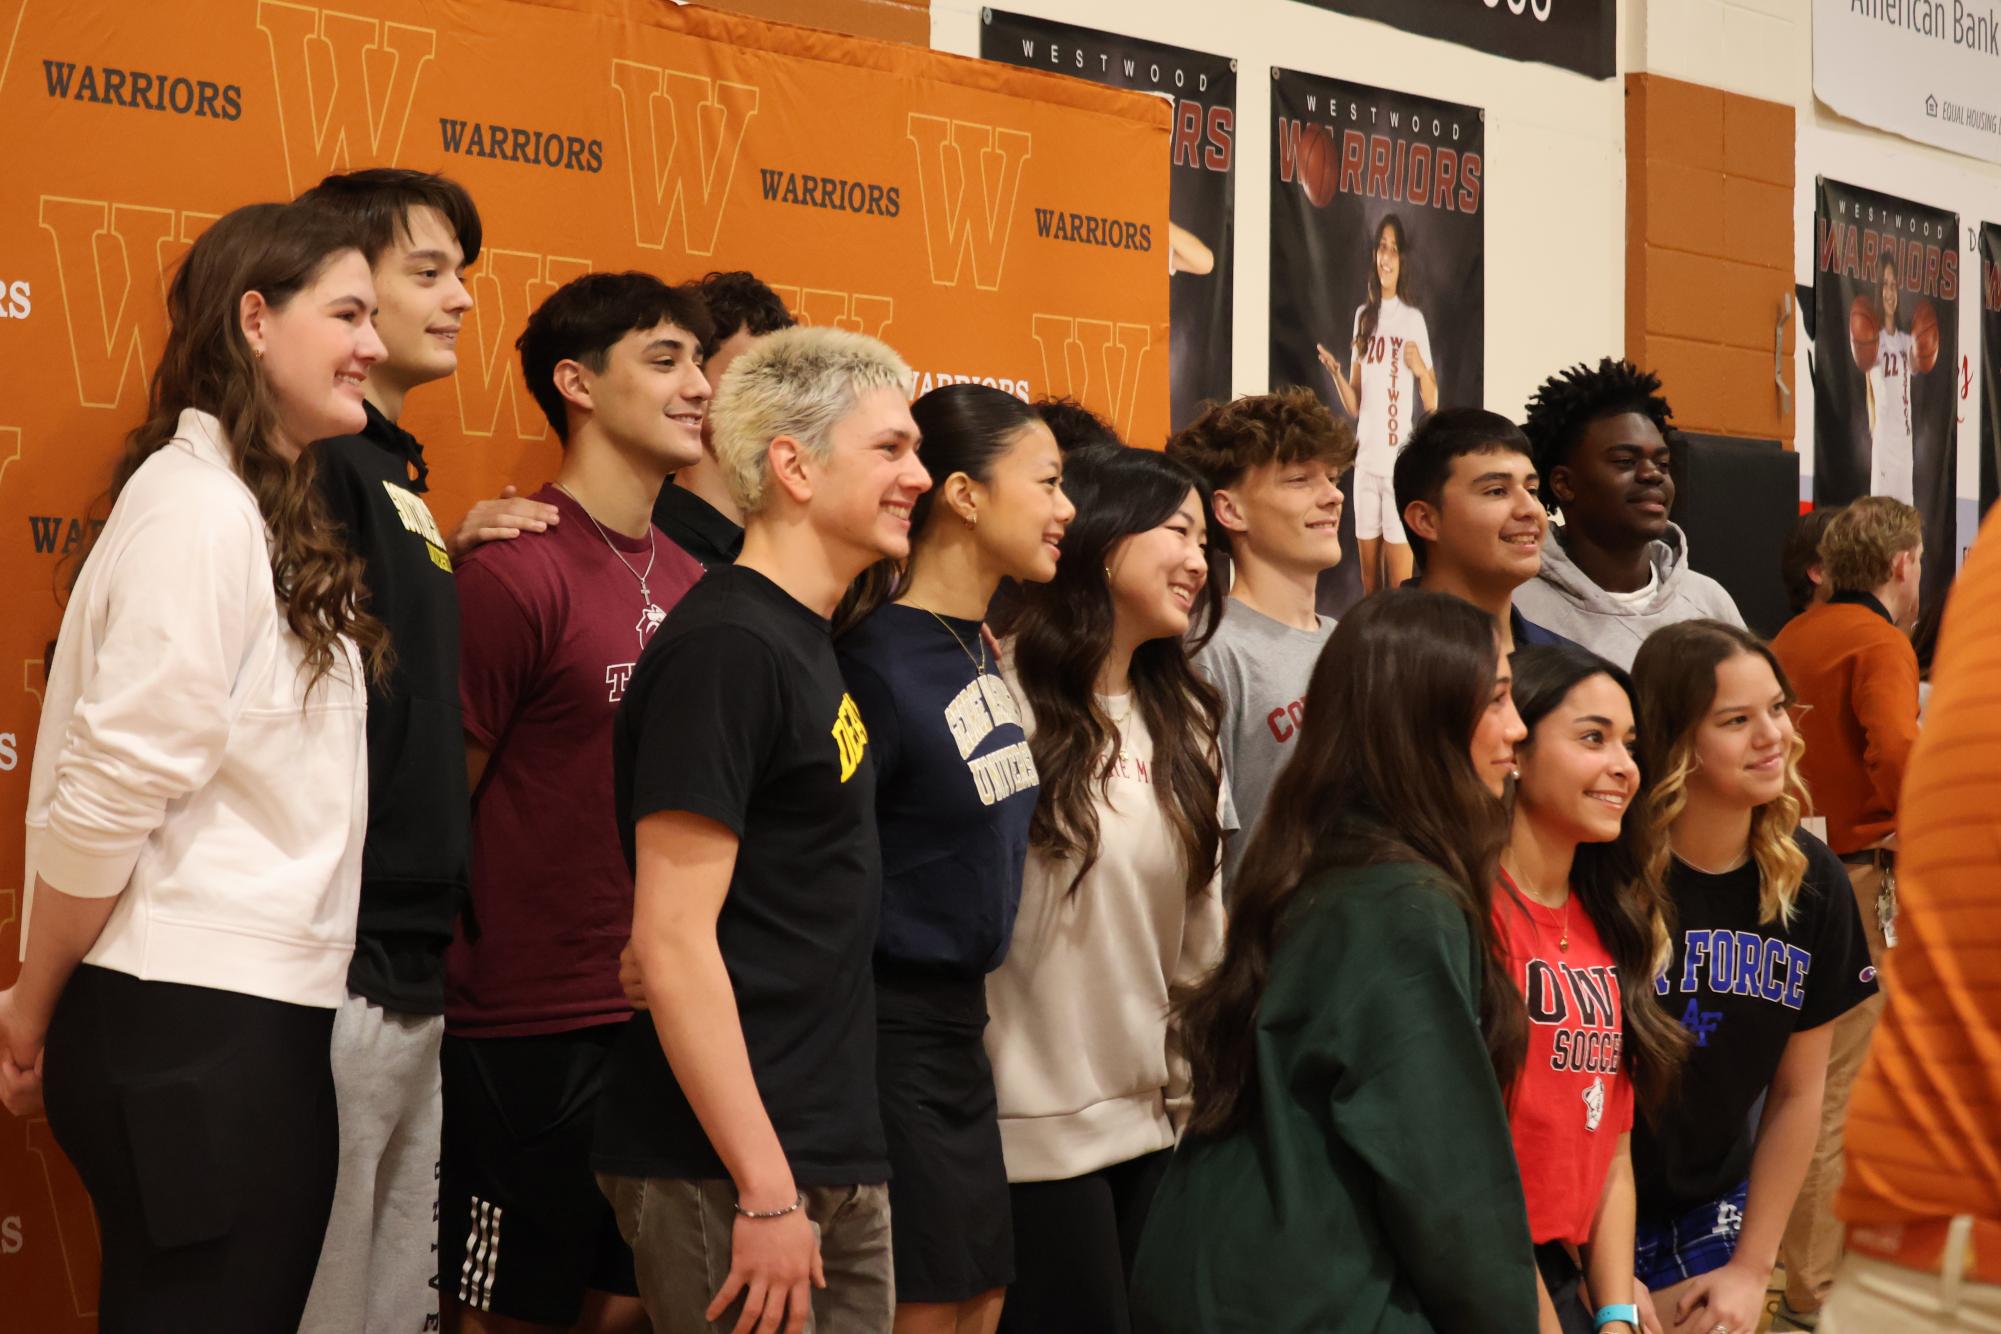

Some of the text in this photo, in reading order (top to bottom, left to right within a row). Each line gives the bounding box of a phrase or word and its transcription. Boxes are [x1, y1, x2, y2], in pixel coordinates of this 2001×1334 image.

[1953, 0, 1999, 56] Bank
[43, 59, 242, 121] WARRIORS
[1022, 39, 1207, 92] WESTWOOD
[1306, 95, 1459, 140] WESTWOOD
[1942, 101, 1964, 125] EQUAL
[1966, 106, 1997, 134] HOUSING
[439, 118, 603, 173] WARRIORS
[1279, 116, 1481, 214] WRRIORS
[760, 168, 900, 218] WARRIORS
[1035, 208, 1151, 252] WARRIORS
[1839, 200, 1943, 240] WESTWOOD
[1367, 336, 1385, 364] 20
[1883, 352, 1899, 378] 22
[1387, 336, 1404, 446] WESTWOOD
[1267, 694, 1308, 743] CO
[1526, 958, 1621, 1030] OW
[1680, 929, 1812, 1011] FORCE
[1550, 1028, 1622, 1075] SOCCE
